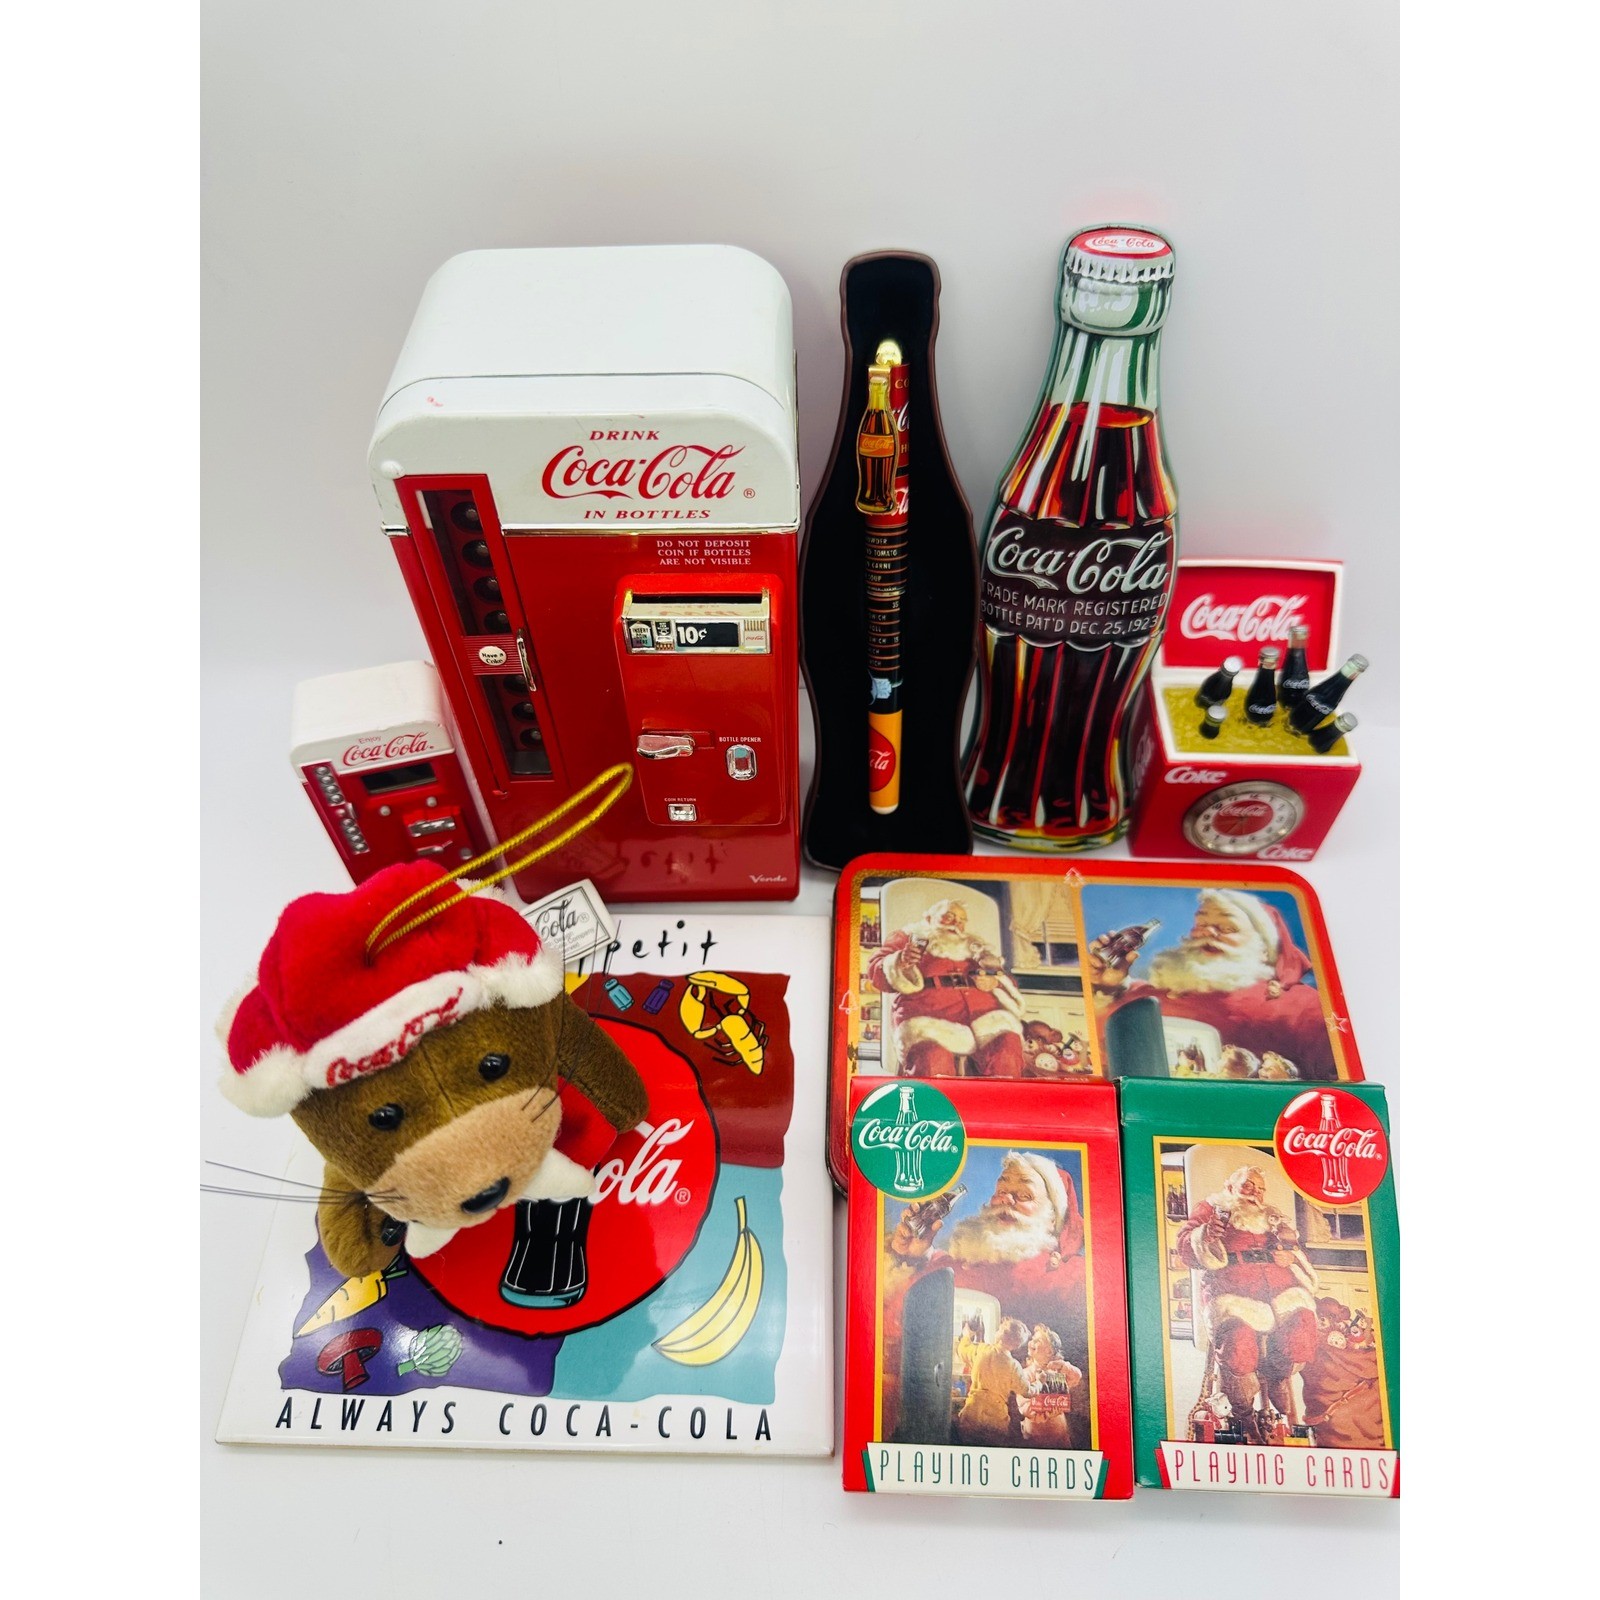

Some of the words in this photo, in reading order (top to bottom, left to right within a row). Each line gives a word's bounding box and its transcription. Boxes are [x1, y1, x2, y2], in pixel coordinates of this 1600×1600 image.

[589, 430, 661, 441] DRINK
[541, 444, 746, 500] Coca-Cola
[583, 509, 606, 520] IN
[615, 509, 711, 520] BOTTLES
[656, 539, 674, 548] DO
[677, 539, 700, 548] NOT
[704, 539, 751, 548] DEPOSIT
[657, 549, 684, 557] COIN
[688, 549, 700, 557] IF
[703, 549, 751, 557] BOTTLES
[659, 558, 681, 566] ARE
[684, 558, 707, 566] NOT
[710, 558, 751, 566] VISIBLE
[986, 527, 1172, 595] Coca-Cola
[982, 579, 1018, 606] TRADE
[1024, 595, 1068, 615] MARK
[1073, 593, 1167, 616] REGISTERED
[981, 599, 1022, 626] BOTTLE
[1026, 615, 1064, 633] PAT'D
[677, 626, 708, 645] 10¢
[343, 732, 429, 767] Coca-Cola
[358, 735, 382, 745] Enjoy
[1164, 766, 1229, 785] Coke
[1256, 843, 1315, 860] Coke
[749, 874, 788, 884] Vendo
[858, 1118, 957, 1152] Coca-Cola
[1283, 1125, 1379, 1159] Coca-Cola
[275, 1396, 457, 1434] ALWAYS
[499, 1402, 772, 1441] COCA-COLA
[880, 1449, 989, 1486] PLAYING
[1011, 1455, 1094, 1491] CARDS
[1175, 1449, 1285, 1486] PLAYING
[1306, 1455, 1389, 1490] CARDS
